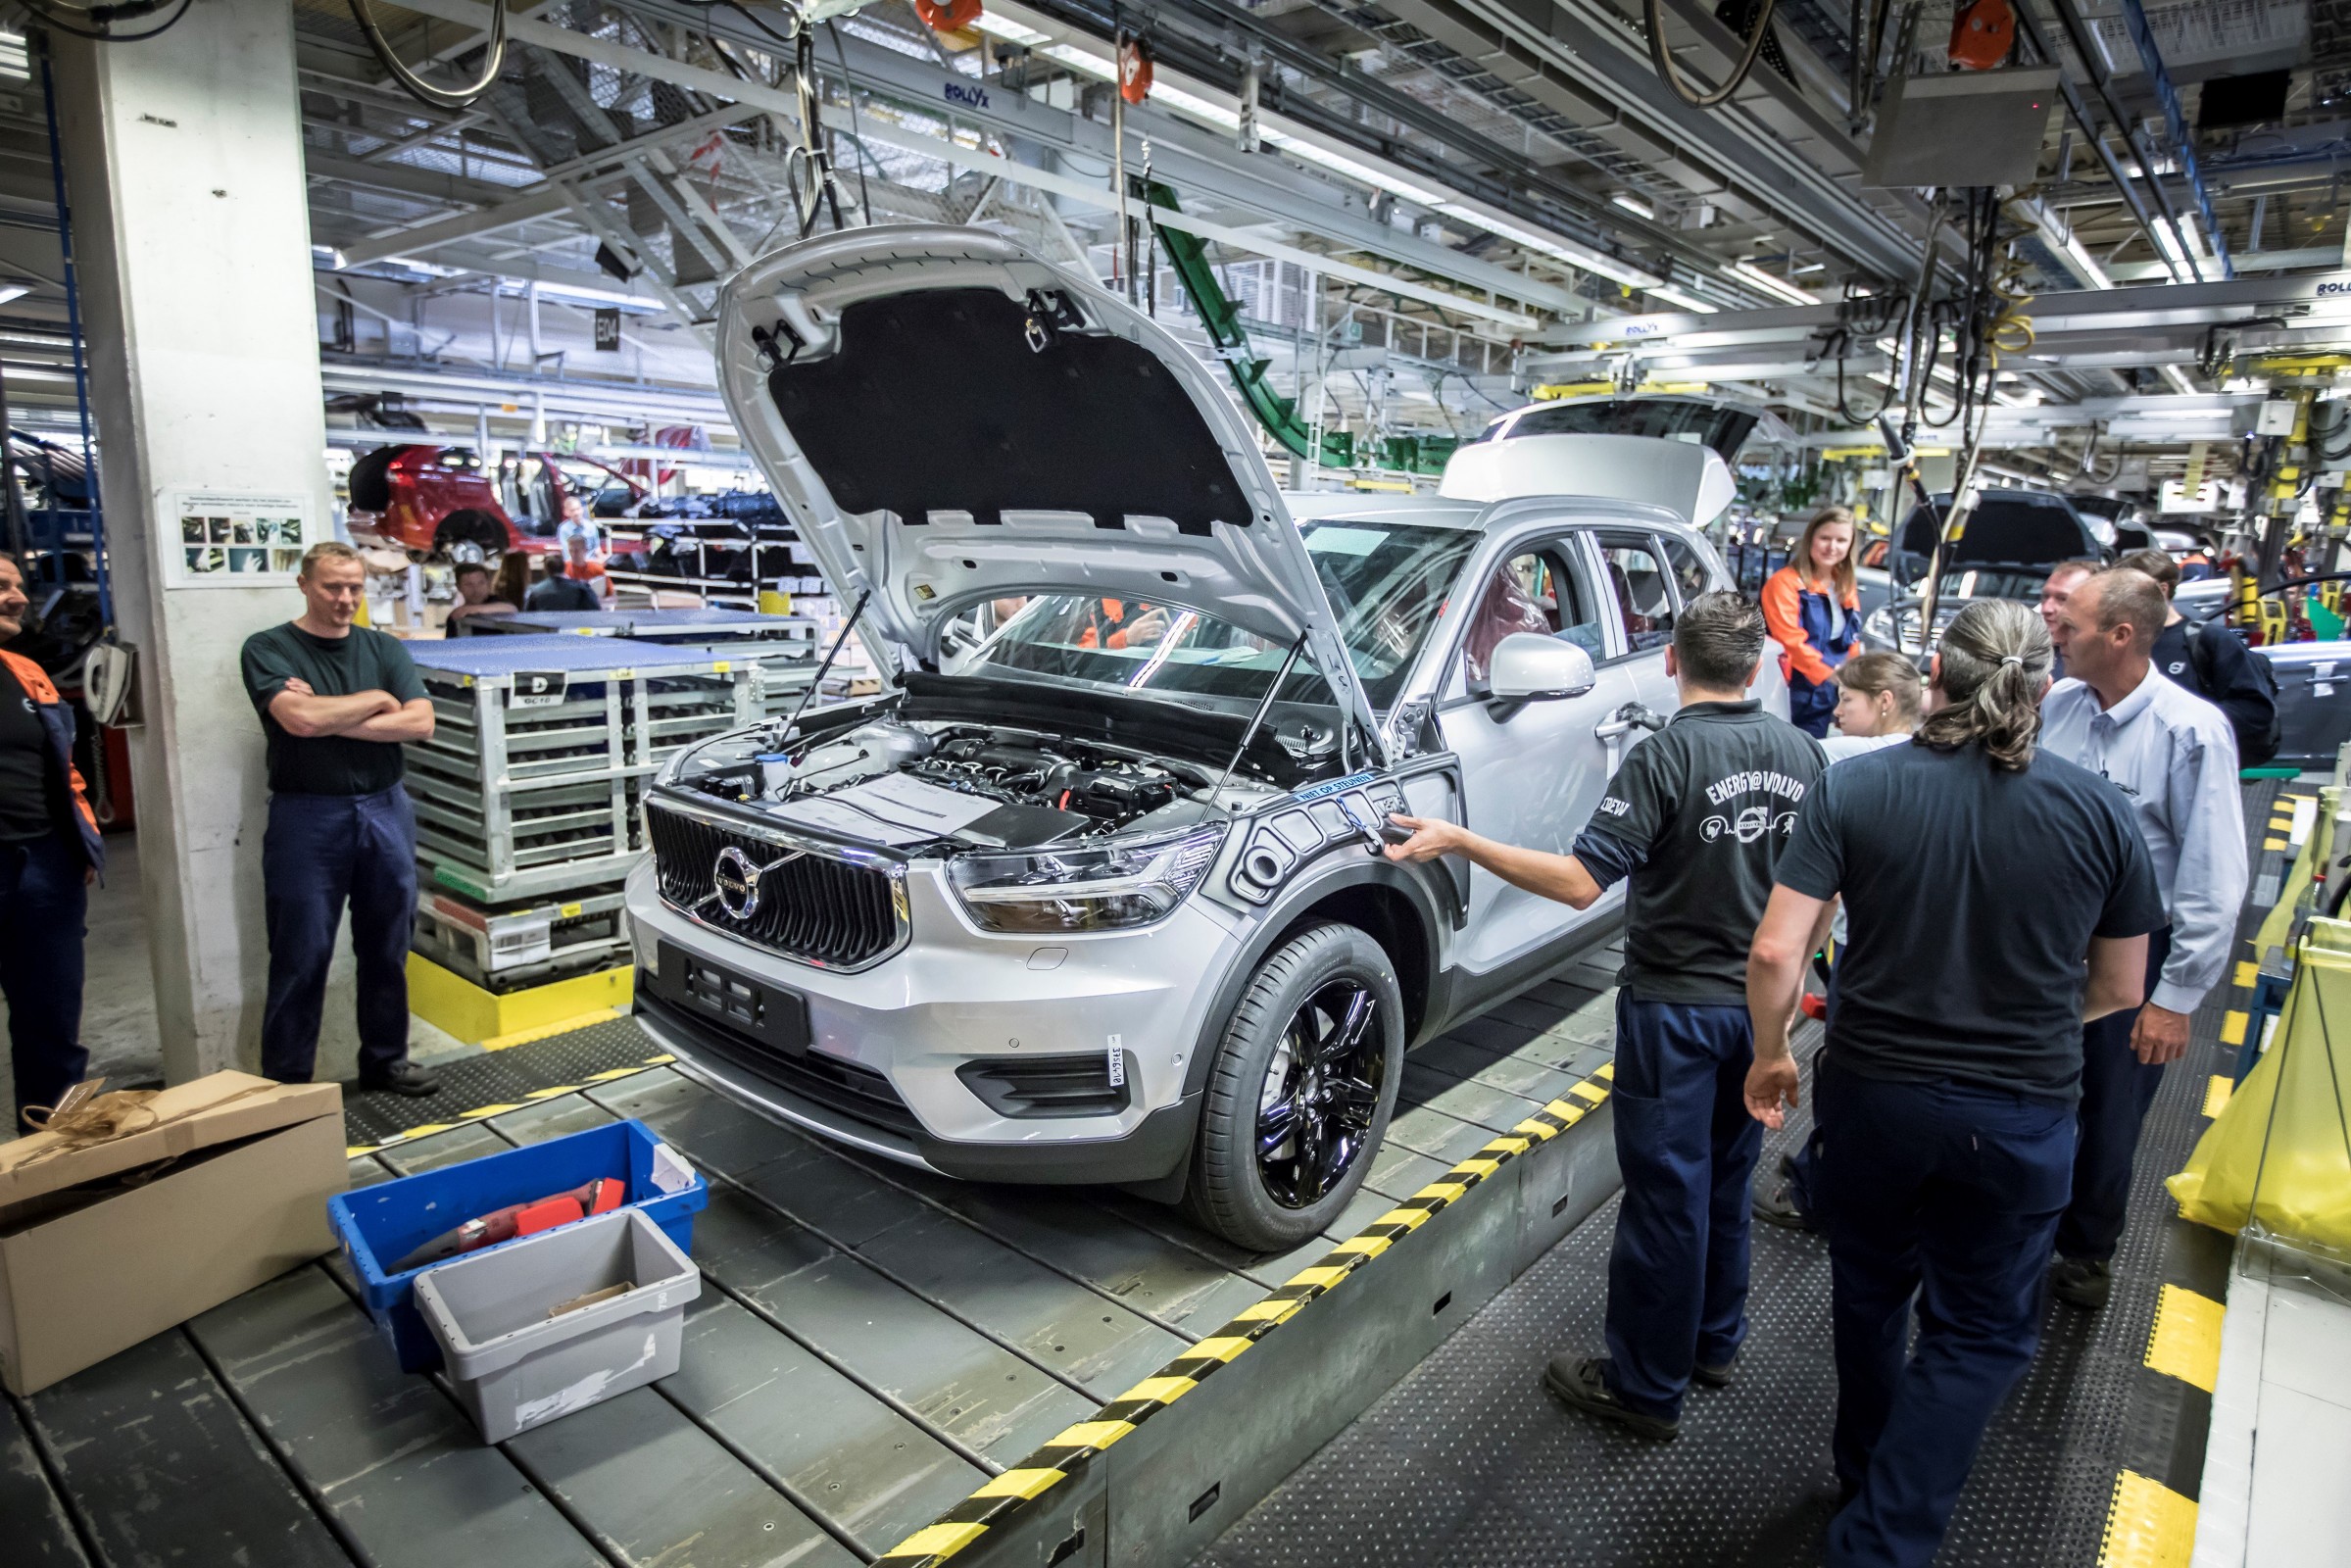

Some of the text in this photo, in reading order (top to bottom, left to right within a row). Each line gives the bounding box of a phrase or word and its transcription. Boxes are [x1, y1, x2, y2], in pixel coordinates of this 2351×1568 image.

[531, 676, 549, 694] D
[1299, 774, 1371, 800] NIET OP STEUNEN
[1599, 796, 1631, 817] CREW
[716, 876, 746, 893] VOLVO
